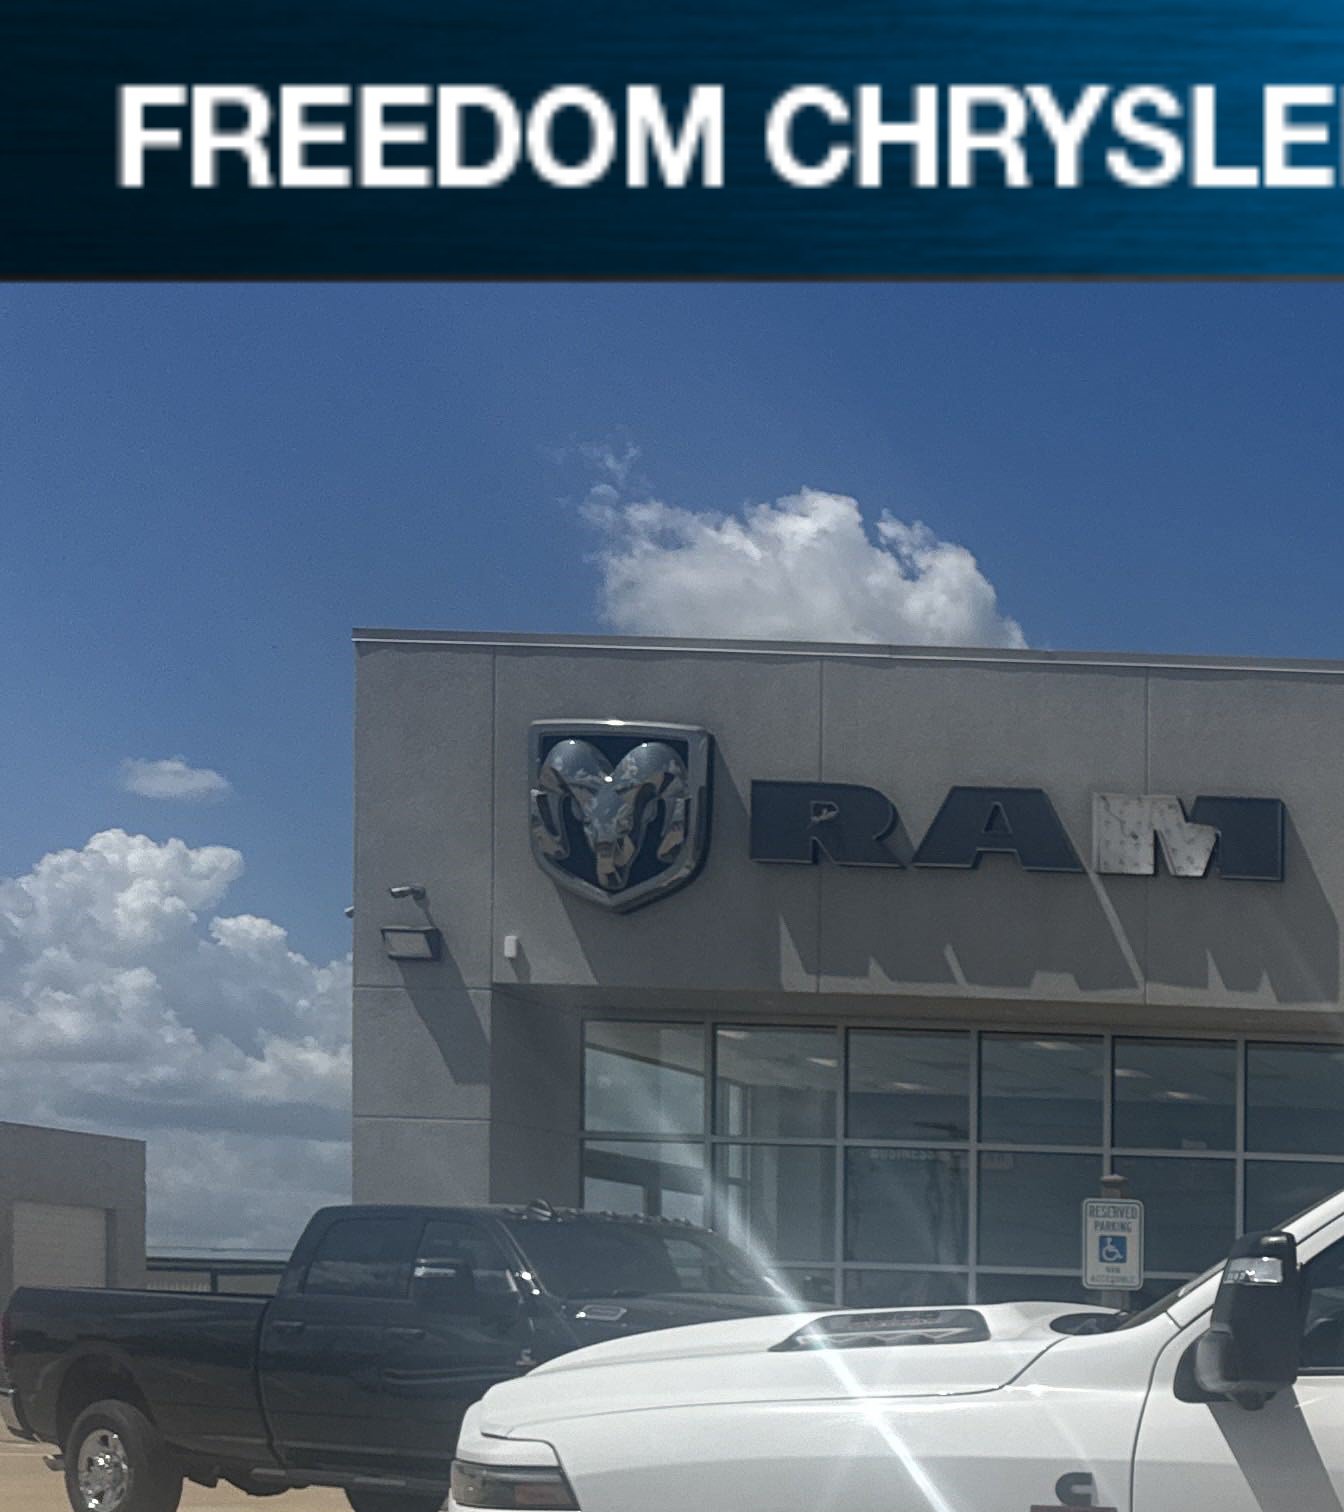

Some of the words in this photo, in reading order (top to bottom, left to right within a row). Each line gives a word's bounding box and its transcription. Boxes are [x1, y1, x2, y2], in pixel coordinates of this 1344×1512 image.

[750, 779, 1285, 882] RAM
[1088, 1205, 1138, 1219] RESERVED
[1094, 1220, 1133, 1233] PARKING
